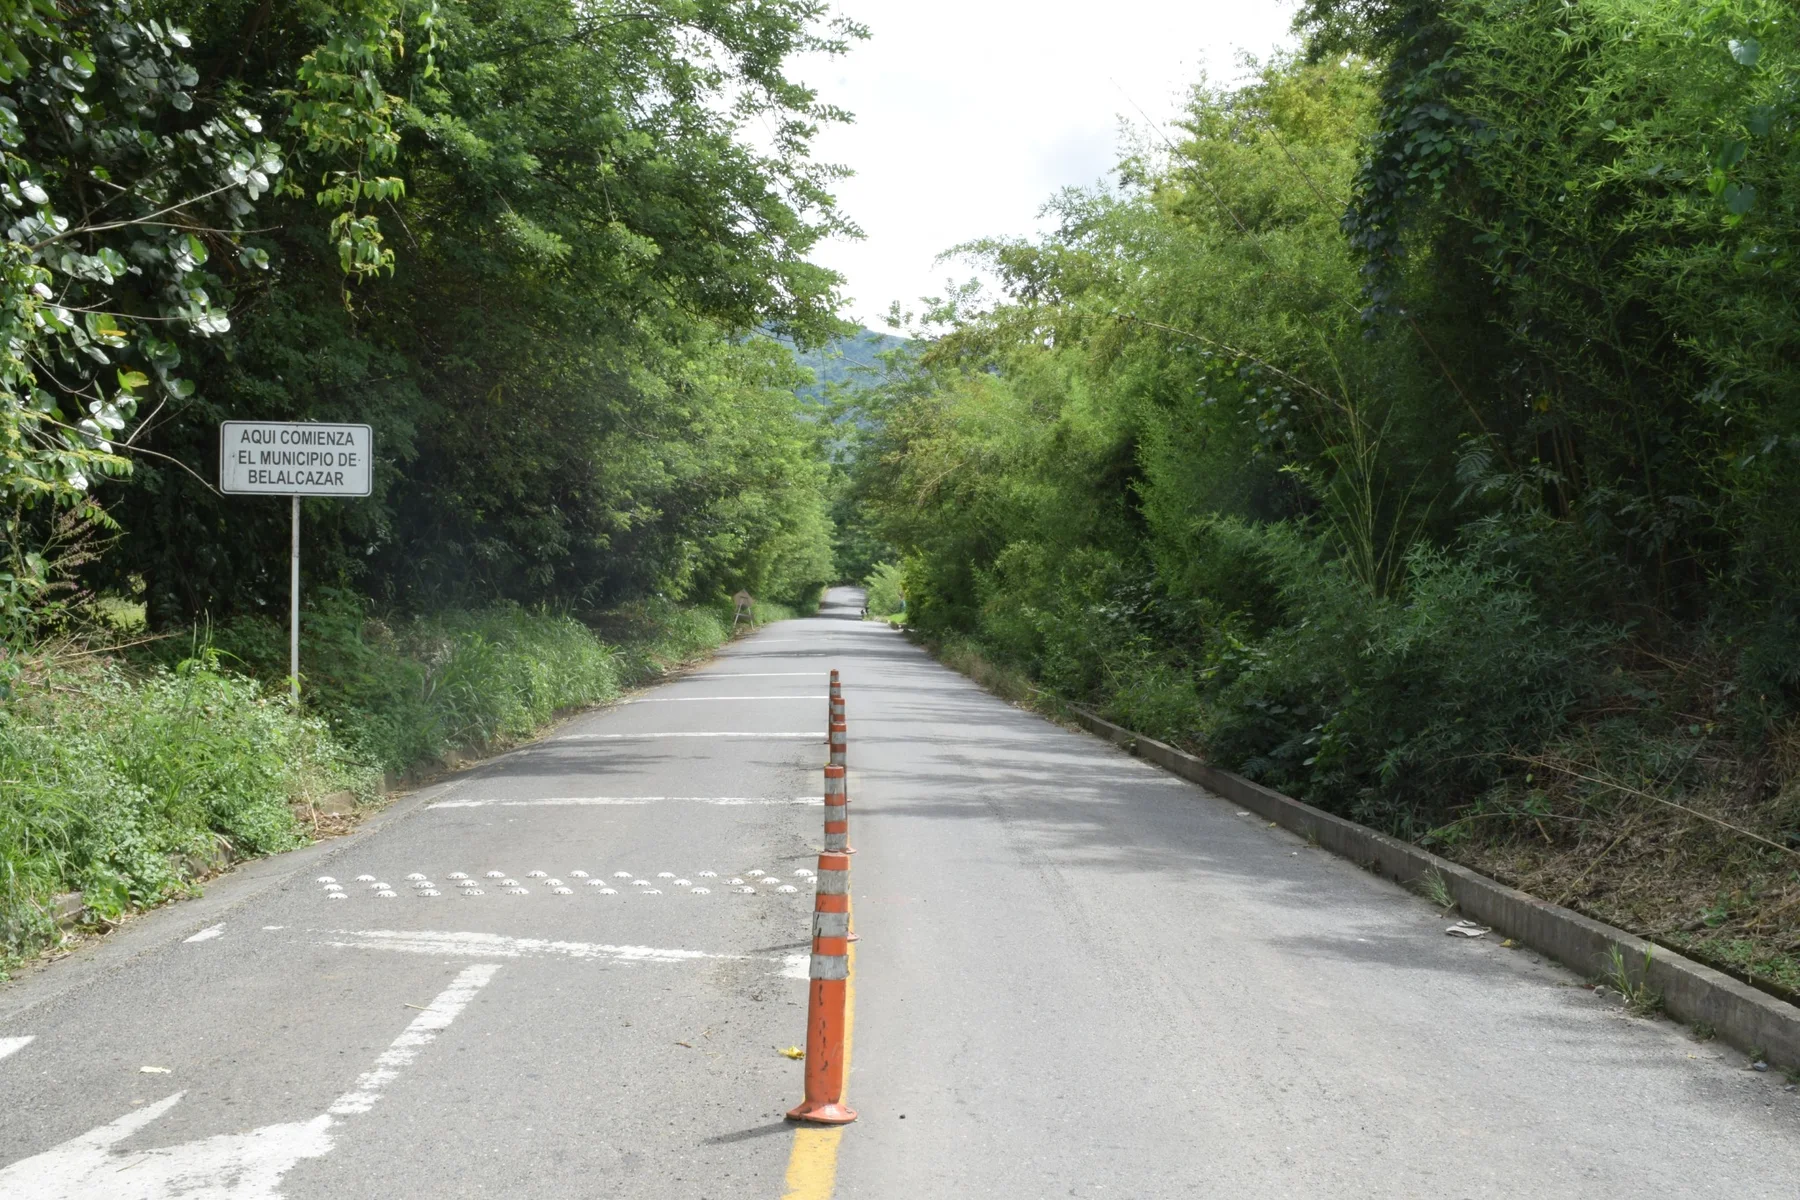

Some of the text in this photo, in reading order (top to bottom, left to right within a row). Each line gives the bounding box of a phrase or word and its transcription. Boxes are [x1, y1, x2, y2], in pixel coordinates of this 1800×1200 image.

[240, 429, 355, 446] AQUI COMIENZA
[238, 450, 357, 467] EL MUNICIPIO DE
[248, 469, 344, 486] BELALCAZAR
